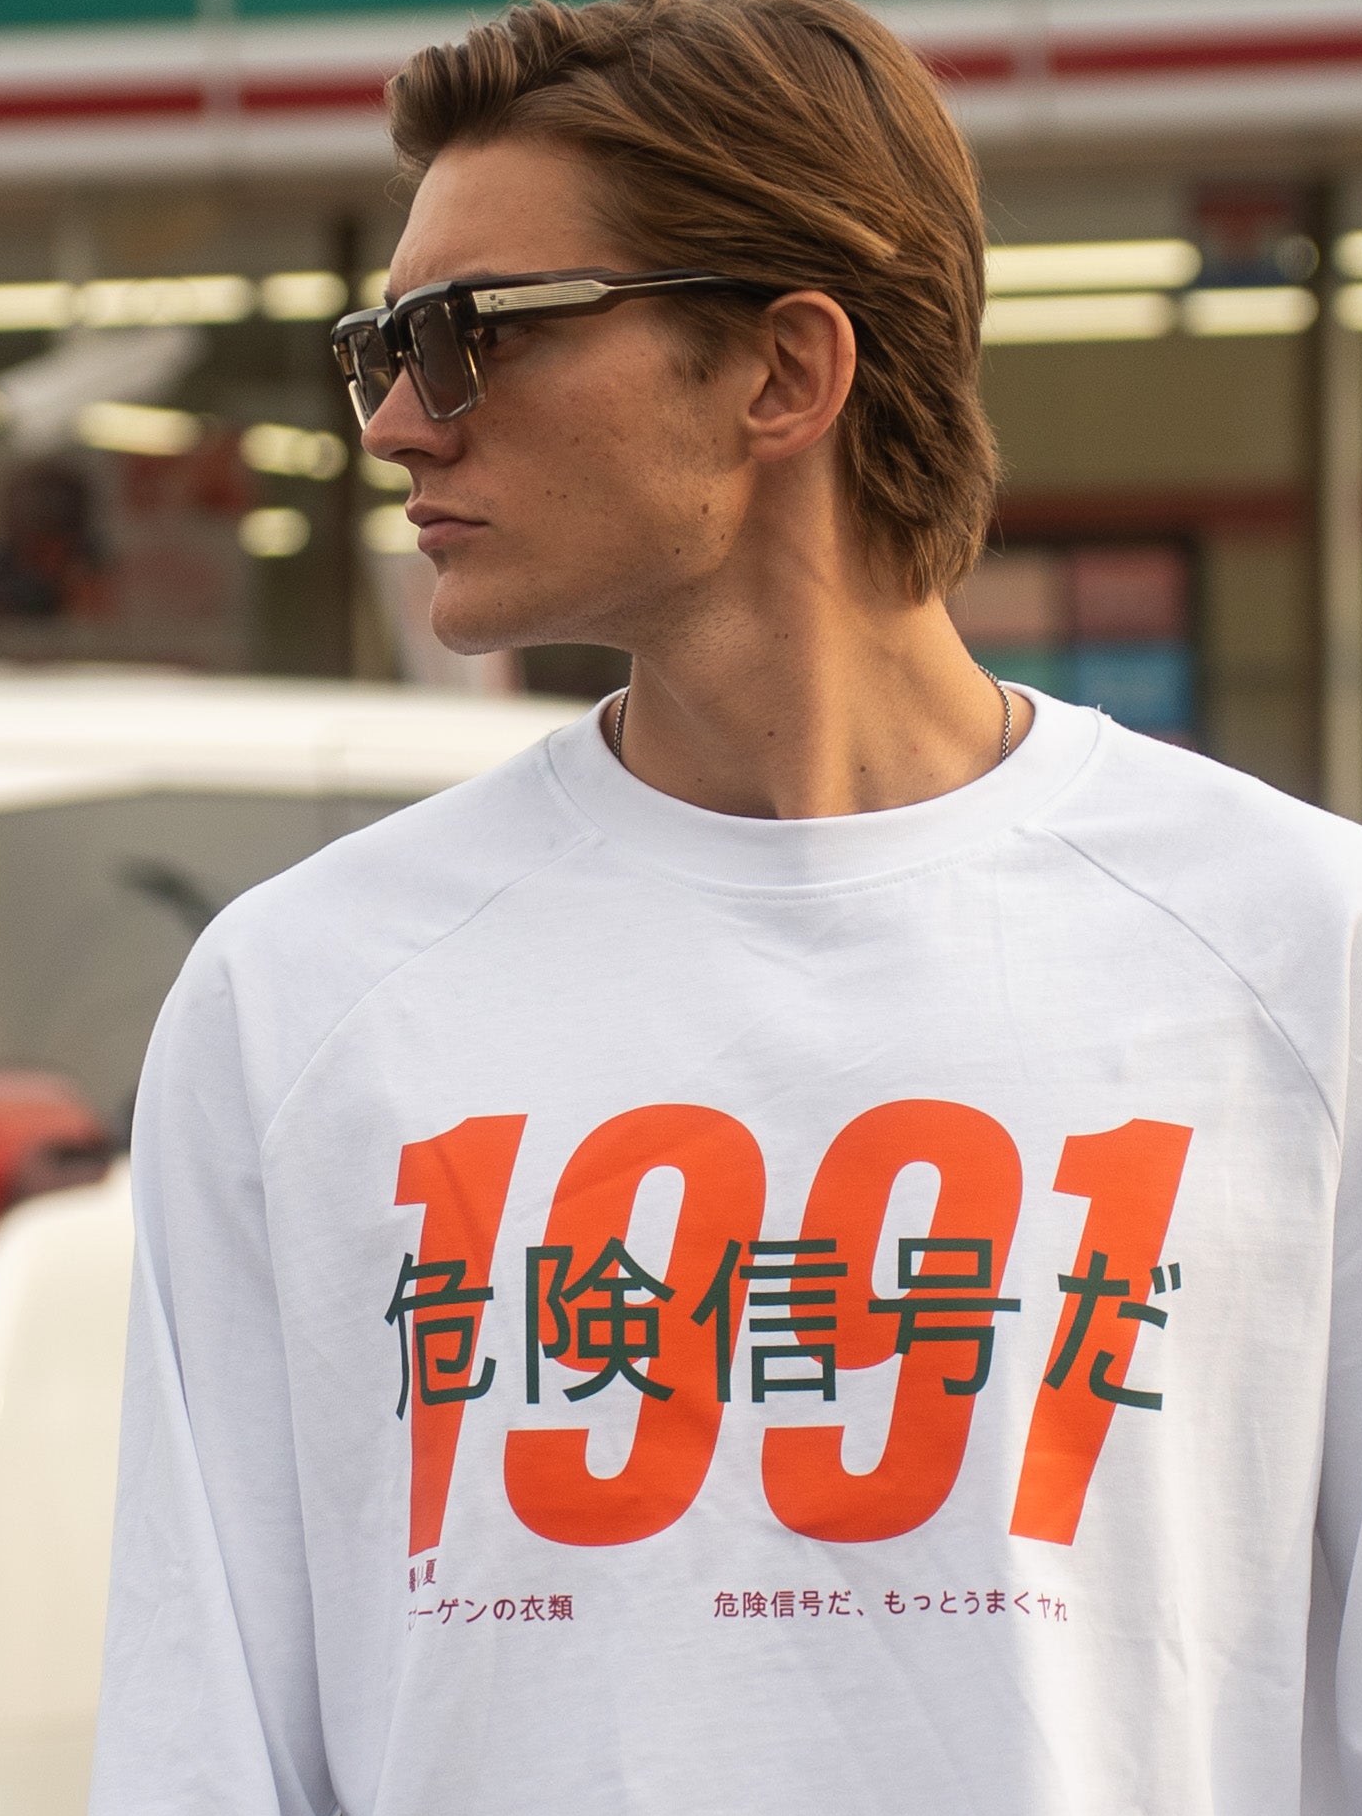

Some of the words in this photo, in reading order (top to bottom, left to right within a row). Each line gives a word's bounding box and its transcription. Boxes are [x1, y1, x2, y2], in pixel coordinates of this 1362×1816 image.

[383, 1237, 1182, 1421] 危険信号だ
[393, 1098, 1194, 1557] 1991
